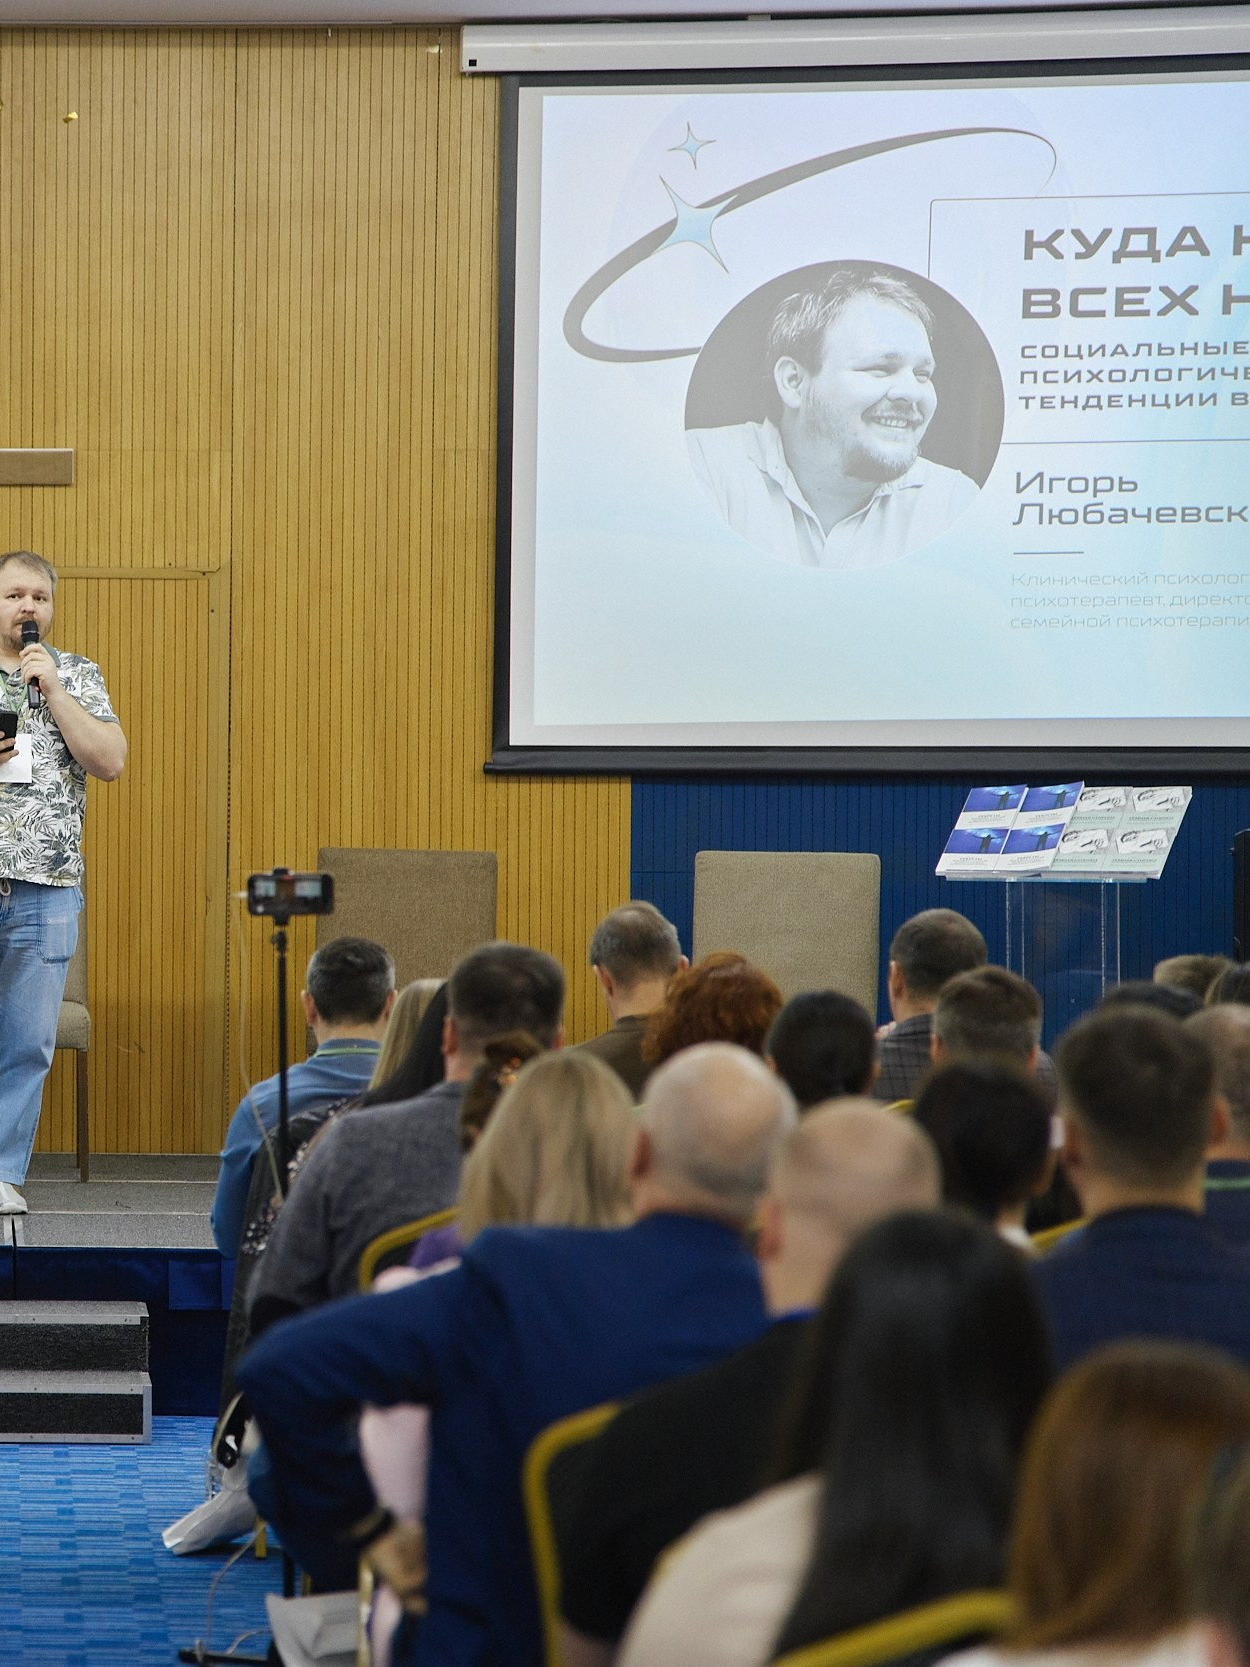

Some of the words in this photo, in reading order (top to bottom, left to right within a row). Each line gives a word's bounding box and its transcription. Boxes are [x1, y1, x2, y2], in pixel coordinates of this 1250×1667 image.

[1024, 225, 1211, 264] КУДА
[1021, 284, 1200, 319] ВСЕХ
[1020, 340, 1250, 360] СОЦИАЛЬНЫЕ
[1018, 392, 1218, 411] ТЕНДЕНЦИИ
[1231, 391, 1249, 407] В
[1015, 470, 1139, 498] Игорь
[1012, 501, 1249, 526] Любачевск
[1011, 571, 1149, 587] Клинический
[1154, 572, 1250, 585] психолог
[1010, 594, 1166, 609] психотерапевт,
[1010, 613, 1111, 630] семейной
[1116, 614, 1250, 630] психотерапи
